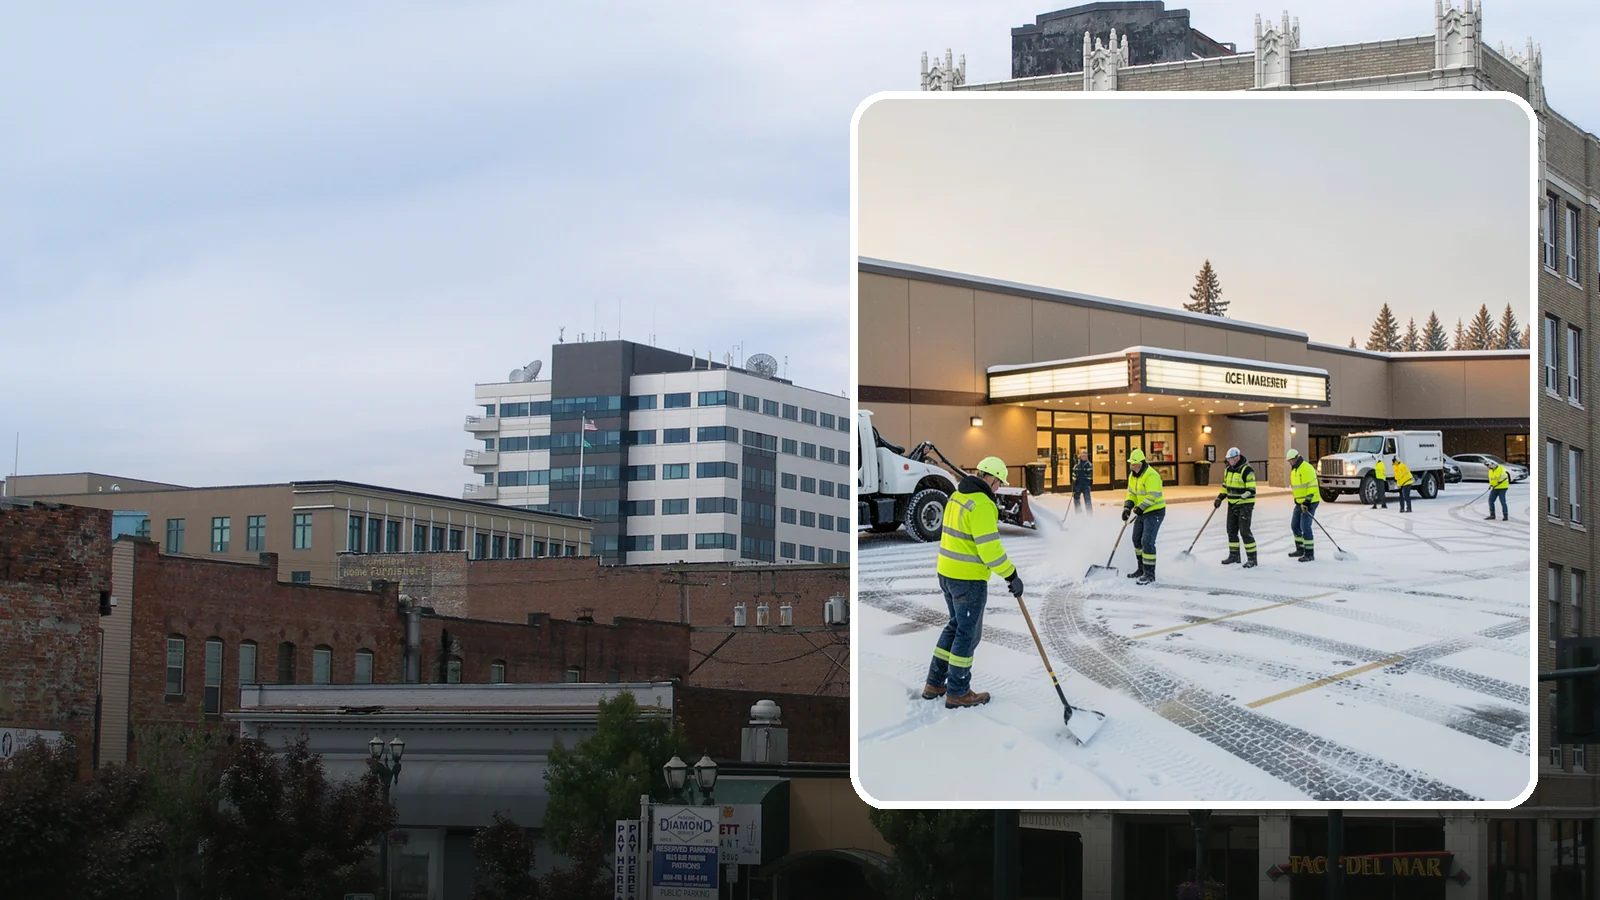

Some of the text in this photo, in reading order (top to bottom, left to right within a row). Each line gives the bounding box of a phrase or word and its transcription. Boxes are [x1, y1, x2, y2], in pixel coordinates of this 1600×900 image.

[370, 566, 427, 577] Furnishers
[660, 818, 713, 833] DIAMOND
[1022, 815, 1069, 828] BUILDING
[656, 845, 716, 854] RESERVED PARKING
[616, 825, 625, 894] PAY HERE
[627, 824, 636, 894] PAY HERE
[721, 851, 739, 862] Soup
[671, 862, 701, 870] PATRONS
[1289, 855, 1442, 877] TAC DEL MAR
[660, 889, 710, 898] PUBLIC PARKING
